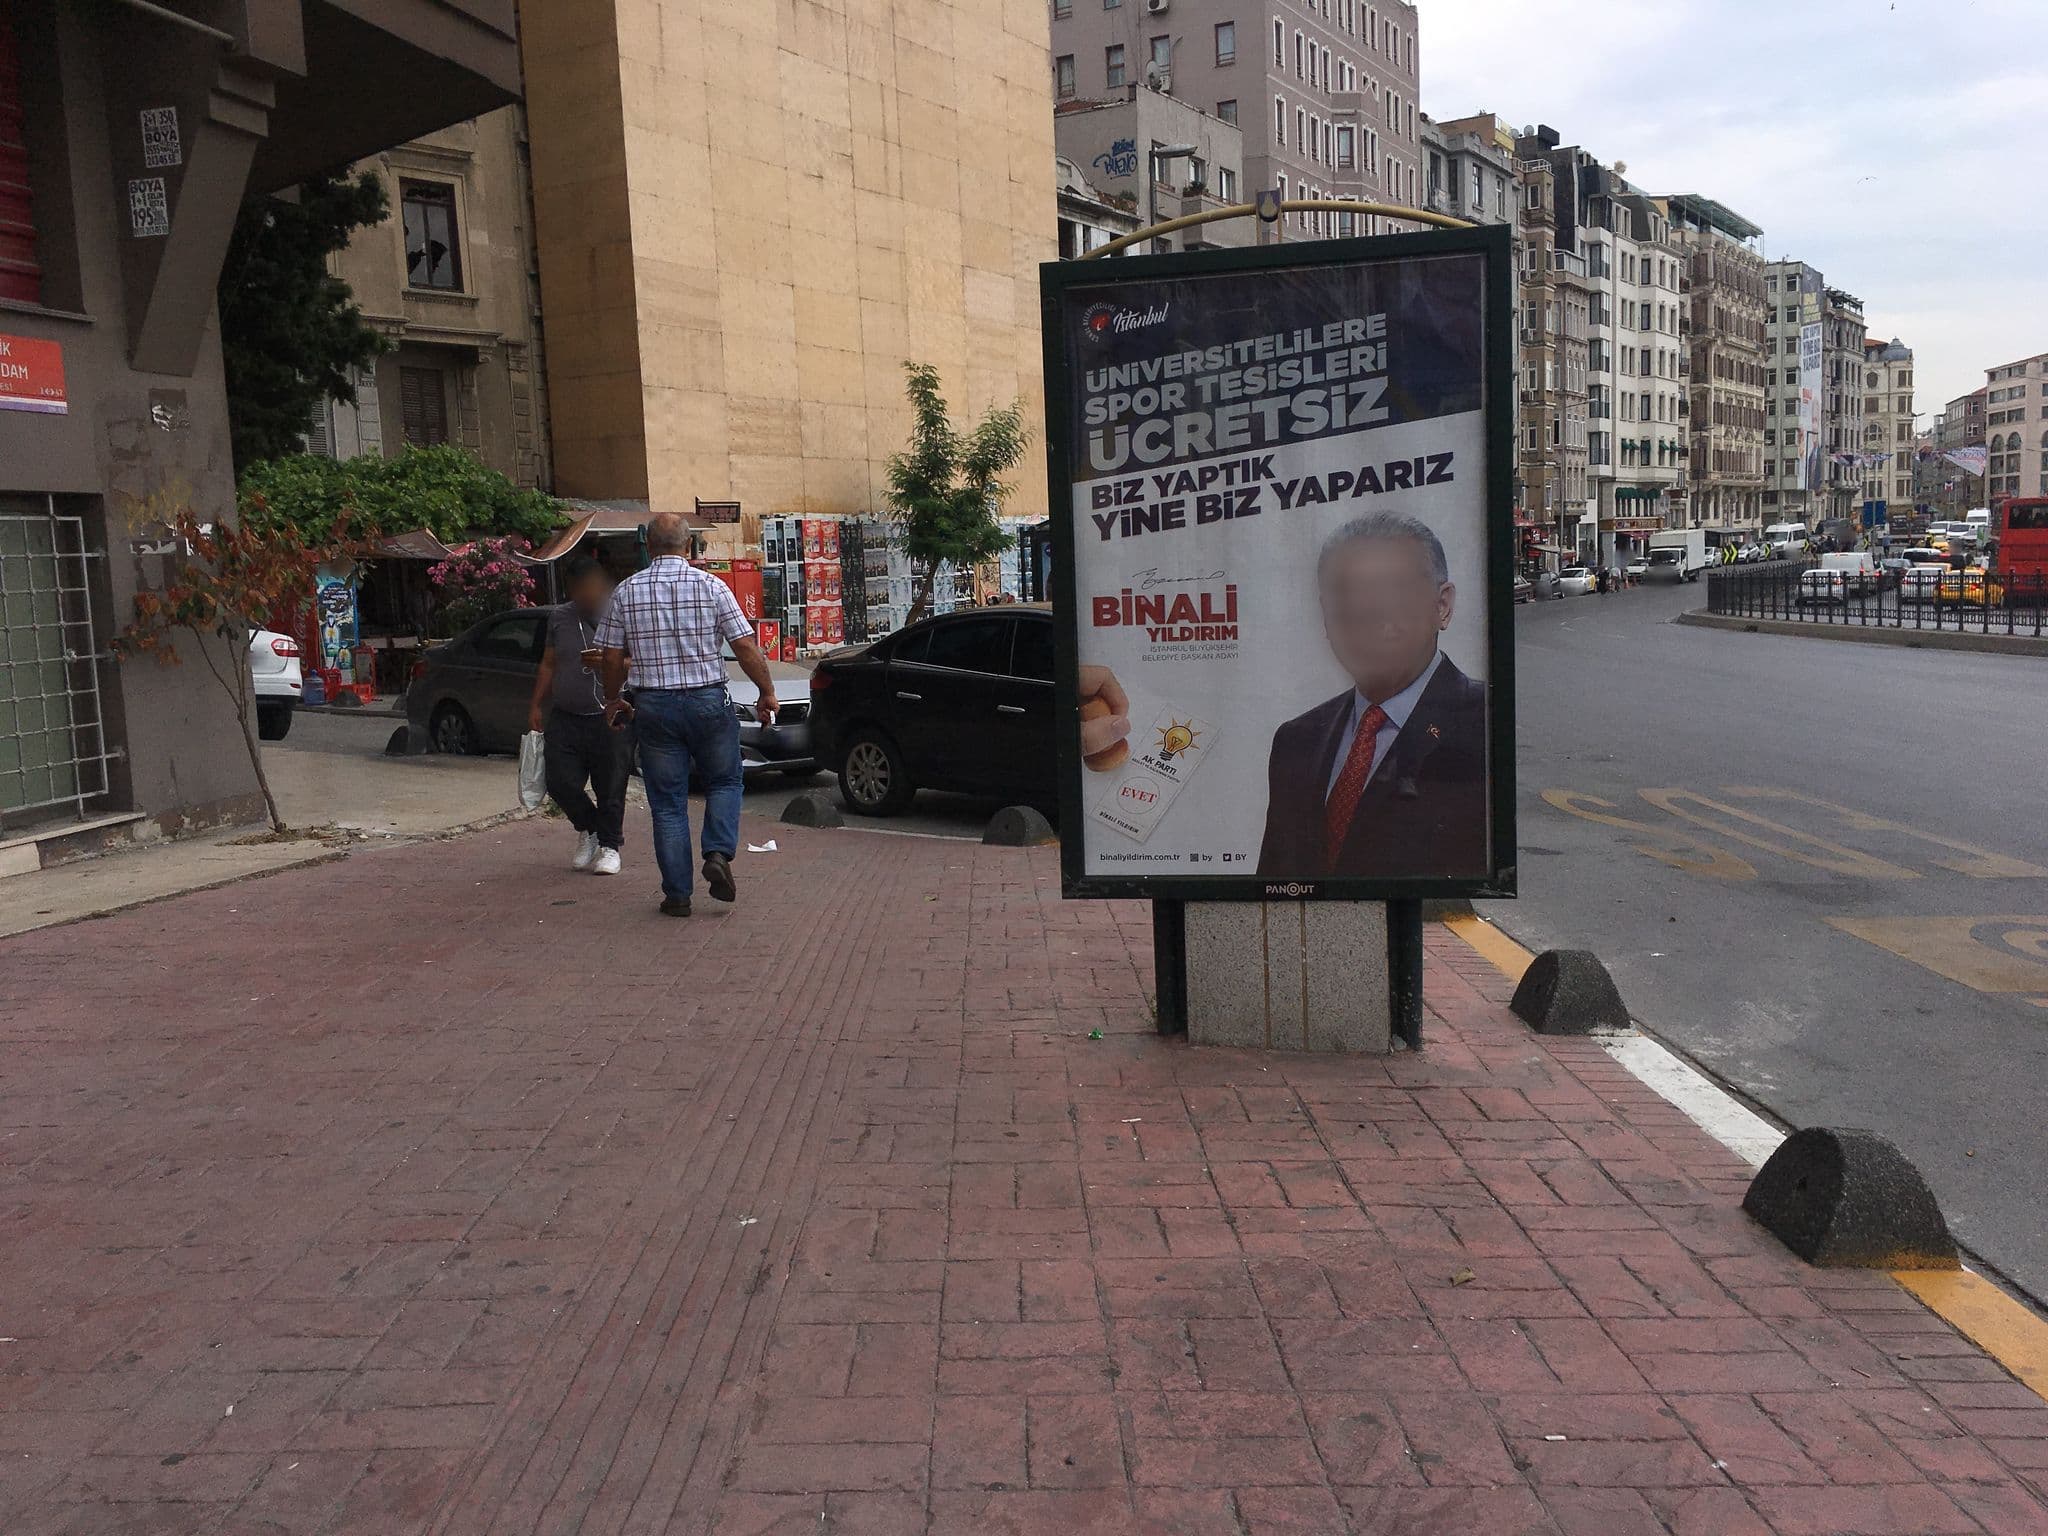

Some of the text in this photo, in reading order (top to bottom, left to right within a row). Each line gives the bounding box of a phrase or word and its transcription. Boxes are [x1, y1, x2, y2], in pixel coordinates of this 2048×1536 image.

[145, 130, 178, 144] BOYA
[130, 179, 163, 193] BOYA
[133, 207, 154, 227] 195
[0, 339, 11, 357] K
[1086, 313, 1387, 393] ÜNİVERSİTELİLERE
[1084, 341, 1388, 425] SPOR TESİSLERİ
[1089, 376, 1389, 471] ÜCRETSİZ
[1092, 454, 1276, 510] BİZ YAPTIK
[1092, 452, 1454, 541] YİNE BİZ YAPARIZ
[1093, 584, 1238, 627] BİNALİ
[1146, 625, 1238, 643] YILDIRIM
[1142, 754, 1155, 765] AK
[1121, 786, 1158, 803] EVET
[1100, 853, 1247, 862] binaliyildirim.com.tr by BY
[1265, 882, 1315, 897] PANOUT
